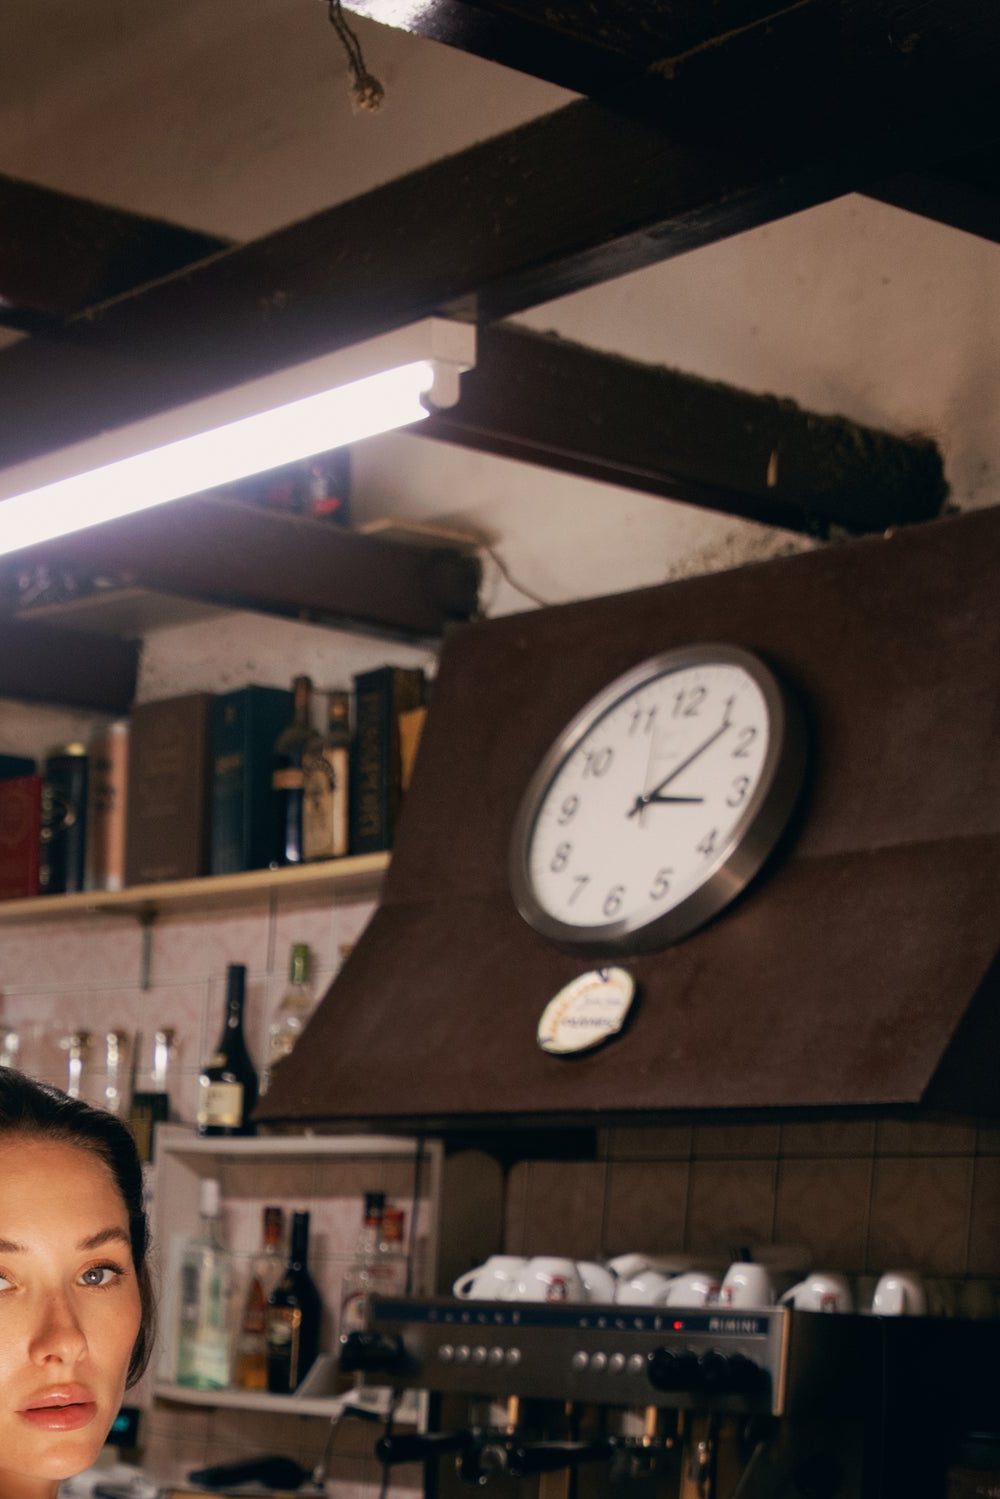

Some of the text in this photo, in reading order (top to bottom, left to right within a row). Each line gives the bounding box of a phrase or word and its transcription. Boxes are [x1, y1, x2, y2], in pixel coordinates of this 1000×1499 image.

[673, 686, 707, 719] 12
[722, 696, 736, 724] 1
[629, 707, 657, 735] 11
[733, 727, 757, 758] 2
[581, 747, 614, 779] 10
[726, 776, 750, 808] 3
[557, 796, 579, 826] 9
[550, 842, 573, 873] 8
[696, 829, 719, 857] 4
[567, 875, 590, 906] 7
[651, 868, 674, 900] 5
[602, 886, 626, 917] 6
